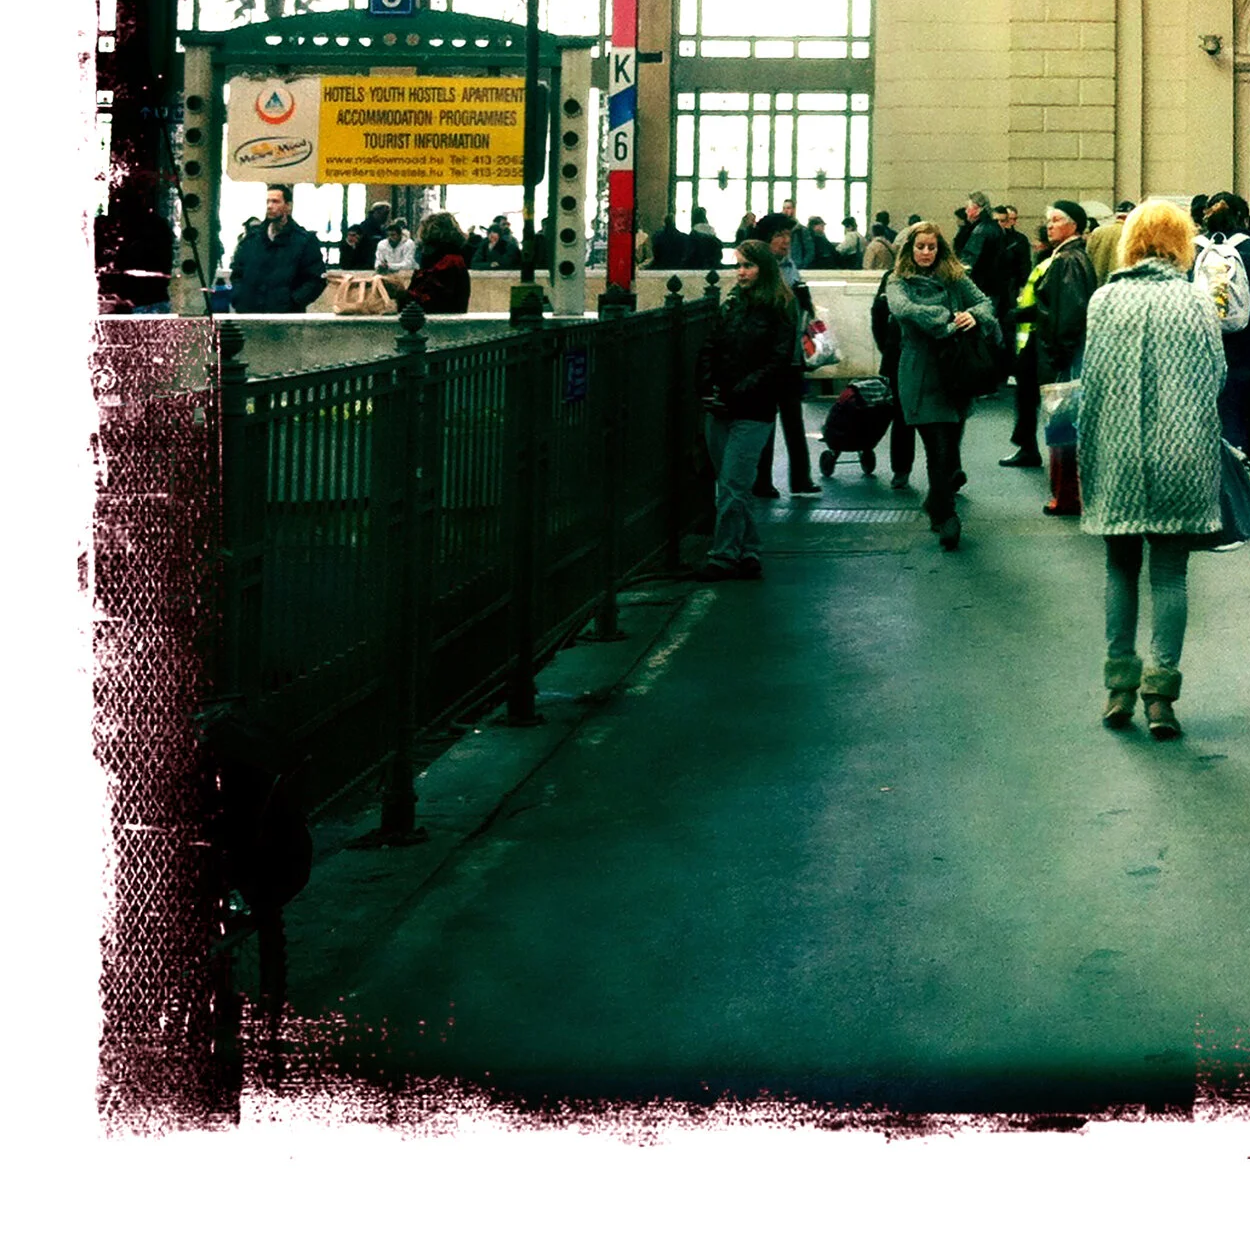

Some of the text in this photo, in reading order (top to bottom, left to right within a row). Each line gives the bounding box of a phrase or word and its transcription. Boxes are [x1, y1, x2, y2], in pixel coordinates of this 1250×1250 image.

[614, 54, 631, 83] K
[323, 86, 365, 103] HOTELS
[368, 86, 405, 103] YOUTH
[408, 87, 456, 103] HOSTELS
[336, 109, 518, 127] ACCOMMODATION PROGRAMMES
[363, 132, 490, 149] TOURIST INFORMATION
[614, 131, 628, 162] 6
